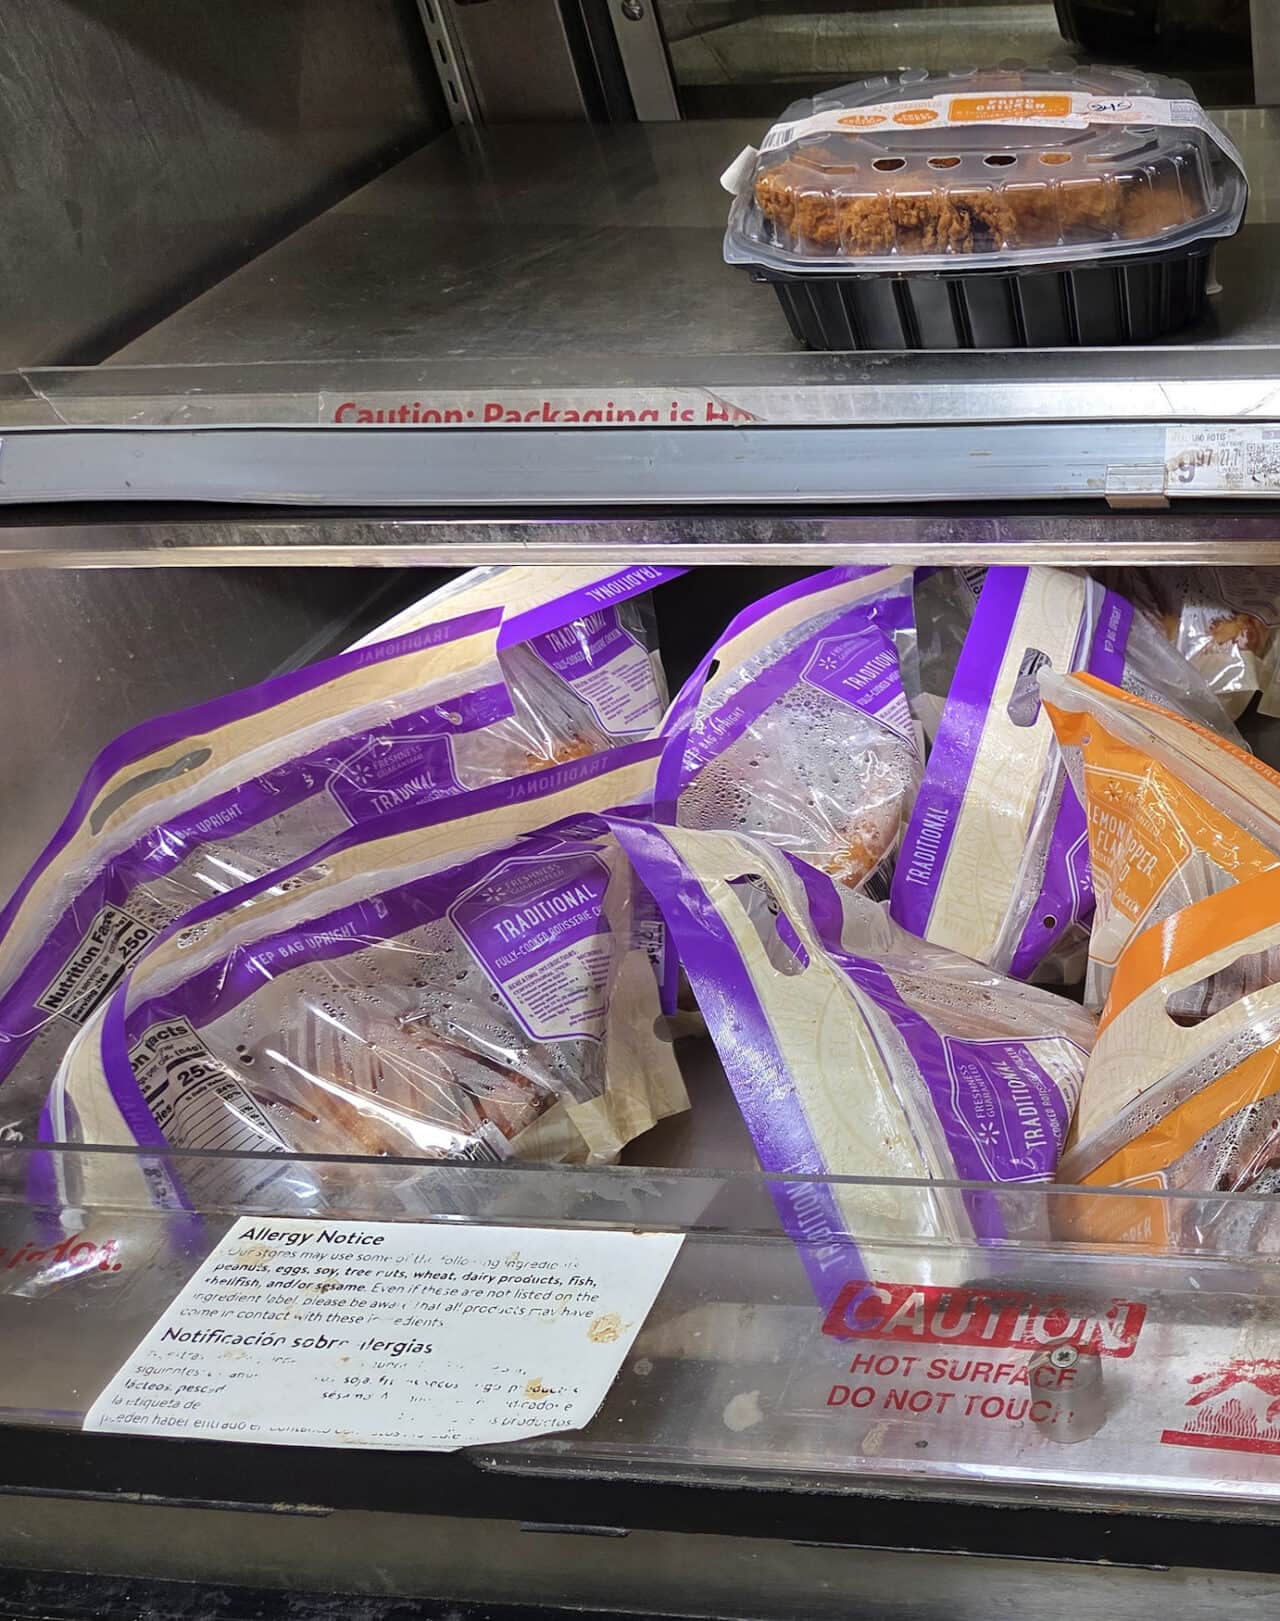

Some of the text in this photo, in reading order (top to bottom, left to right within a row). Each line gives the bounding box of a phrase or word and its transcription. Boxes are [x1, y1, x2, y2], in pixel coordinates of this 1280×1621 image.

[585, 566, 662, 602] TRADITIONAL
[196, 803, 244, 834] UPRIGHT
[1087, 803, 1126, 839] LEMON
[905, 807, 949, 886] TRADITIONAL
[493, 883, 598, 944] TRADITIONAL
[118, 928, 149, 960] 250
[278, 941, 305, 958] BAG
[44, 946, 99, 1009] Nutrition
[959, 1064, 986, 1119] FRESHNESS
[968, 1063, 996, 1118] GUARANTEED
[992, 1060, 1048, 1150] TRADITIONAL
[239, 1227, 385, 1246] Allergy Notice
[300, 1251, 327, 1262] may
[330, 1252, 351, 1261] use
[266, 1277, 312, 1290] and/or
[370, 1283, 405, 1294] Even
[407, 1284, 419, 1295] if
[420, 1284, 459, 1297] these
[485, 1287, 512, 1299] not
[513, 1288, 551, 1301] listed
[554, 1291, 574, 1303] on
[575, 1291, 600, 1304] the
[314, 1266, 339, 1278] soy,
[345, 1267, 372, 1278] tree
[462, 1272, 496, 1284] dairy
[497, 1273, 563, 1287] products,
[567, 1275, 597, 1288] fish,
[192, 1292, 262, 1305] ingredient
[301, 1296, 347, 1309] please
[349, 1298, 368, 1309] be
[236, 1309, 291, 1321] contact
[324, 1312, 364, 1324] these
[844, 1286, 1134, 1349] CAUTION
[161, 1327, 285, 1347] Notificación
[850, 1353, 1078, 1388] HOT SURFACE
[112, 1395, 124, 1407] la
[183, 1398, 201, 1410] de
[827, 1385, 1075, 1424] DO NOT TOUC
